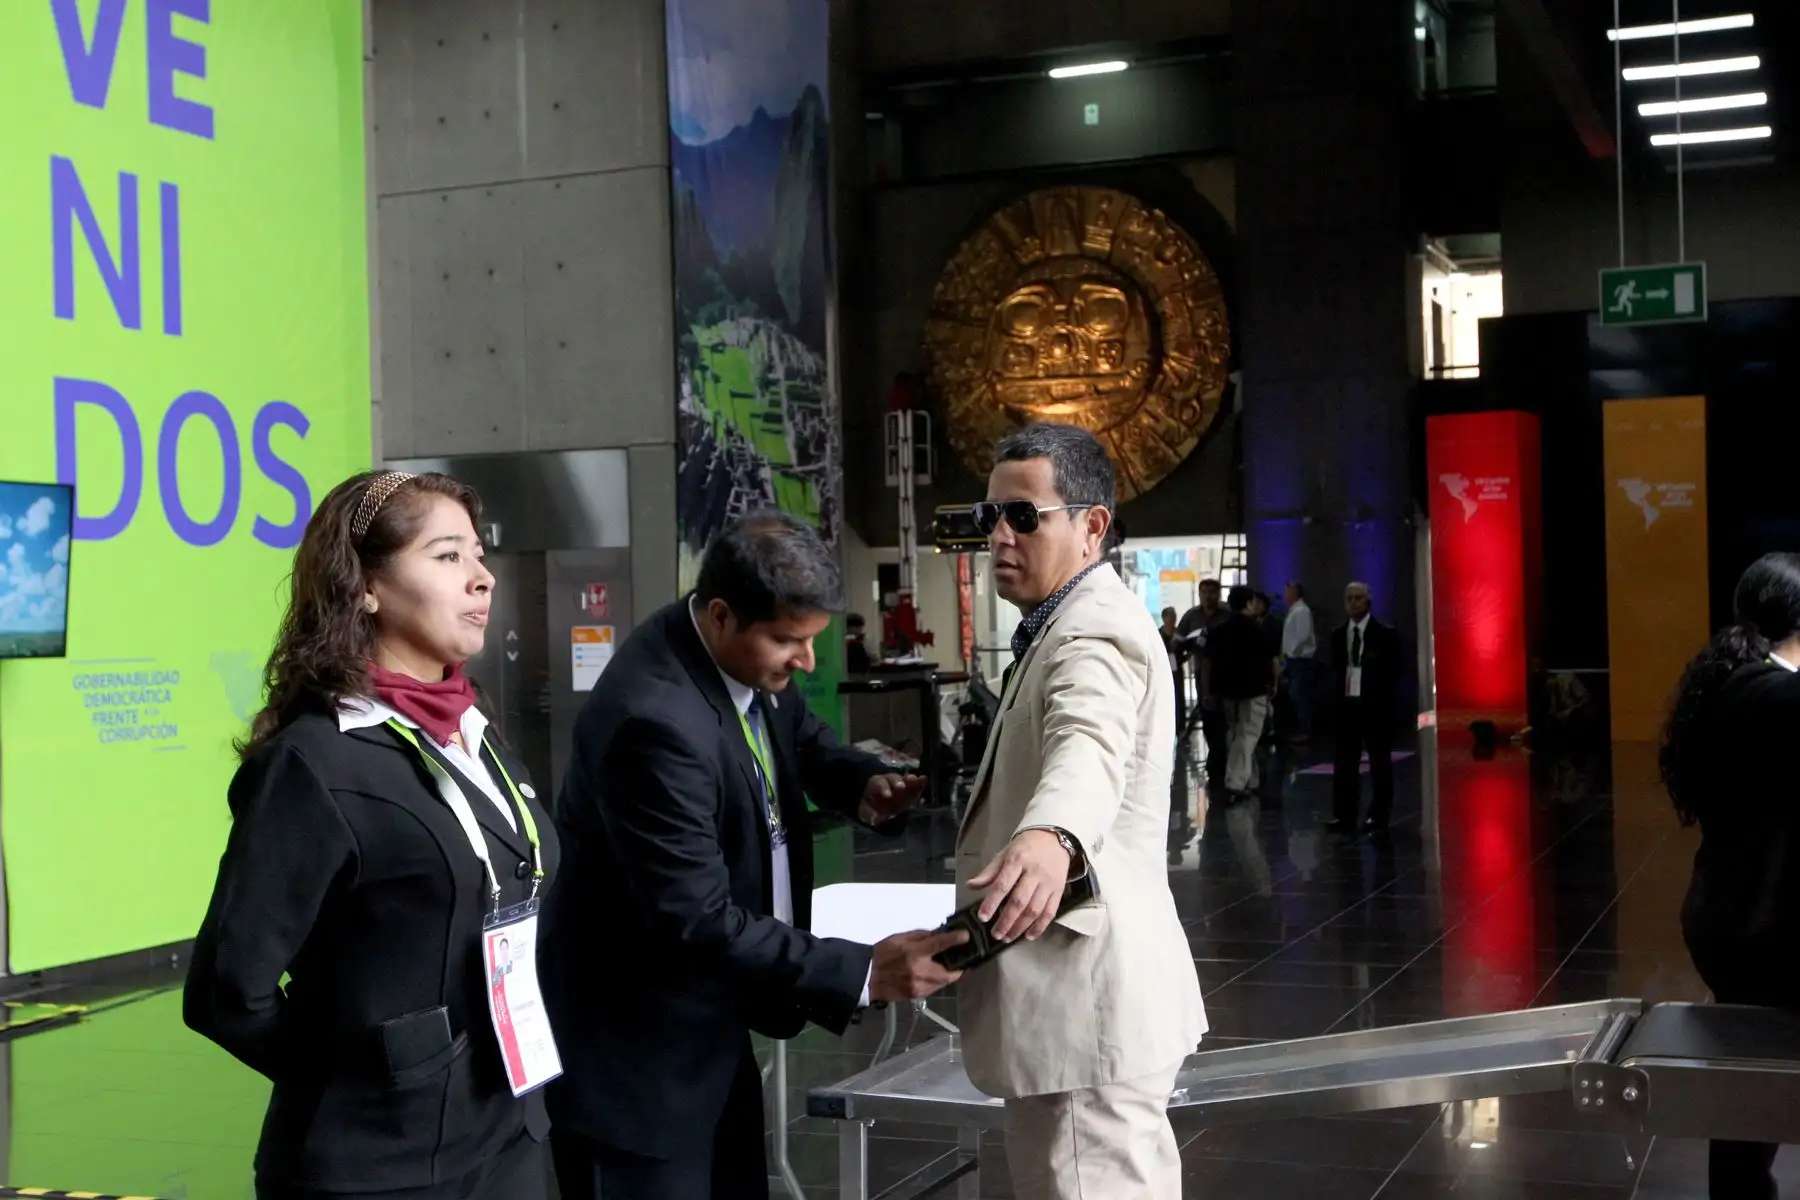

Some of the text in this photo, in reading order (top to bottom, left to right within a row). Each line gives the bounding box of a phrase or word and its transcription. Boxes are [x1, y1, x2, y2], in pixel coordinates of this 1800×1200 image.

[49, 0, 215, 140] VE
[50, 154, 182, 337] NI
[53, 376, 312, 548] DOS
[73, 671, 179, 690] GOBERNABILIDAD
[92, 710, 138, 725] FRENTE
